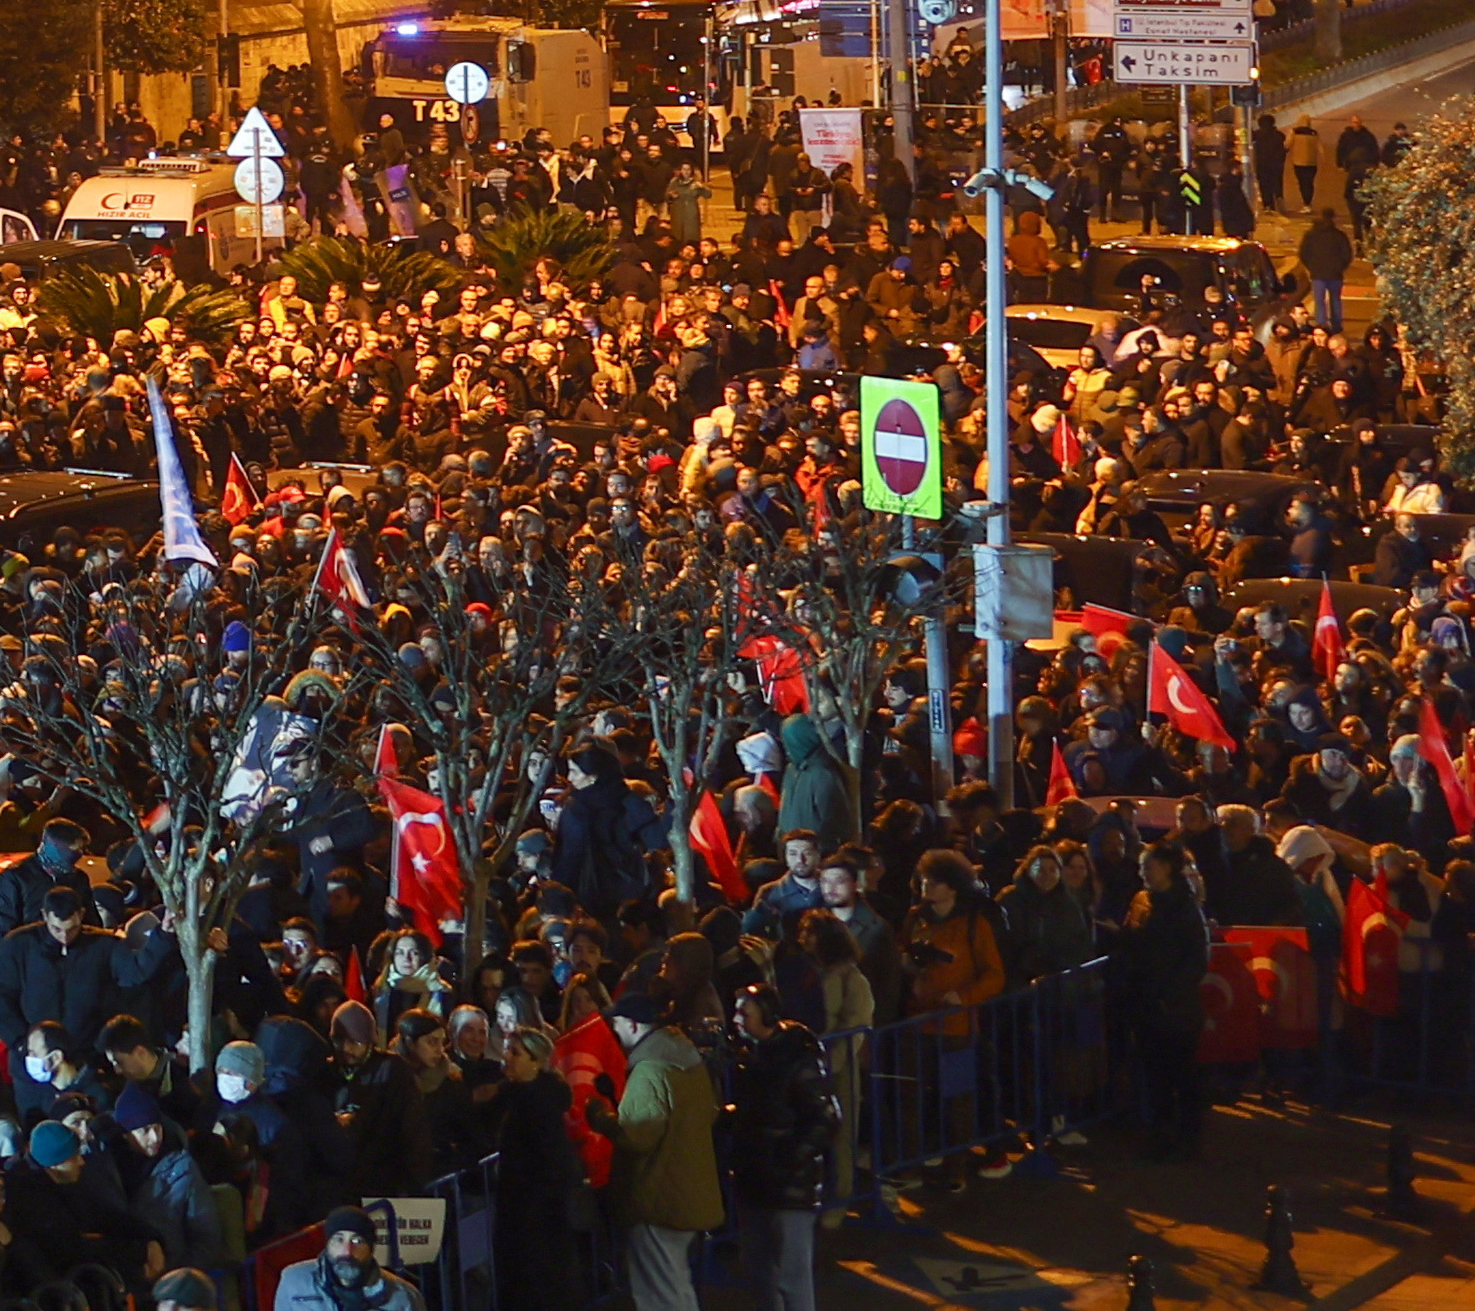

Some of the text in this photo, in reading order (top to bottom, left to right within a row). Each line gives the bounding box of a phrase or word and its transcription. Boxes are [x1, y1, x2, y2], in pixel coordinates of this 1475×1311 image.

[1144, 49, 1239, 63] Unkapanı
[1144, 64, 1219, 77] Taksim
[412, 100, 461, 123] T 43
[134, 195, 153, 204] 112
